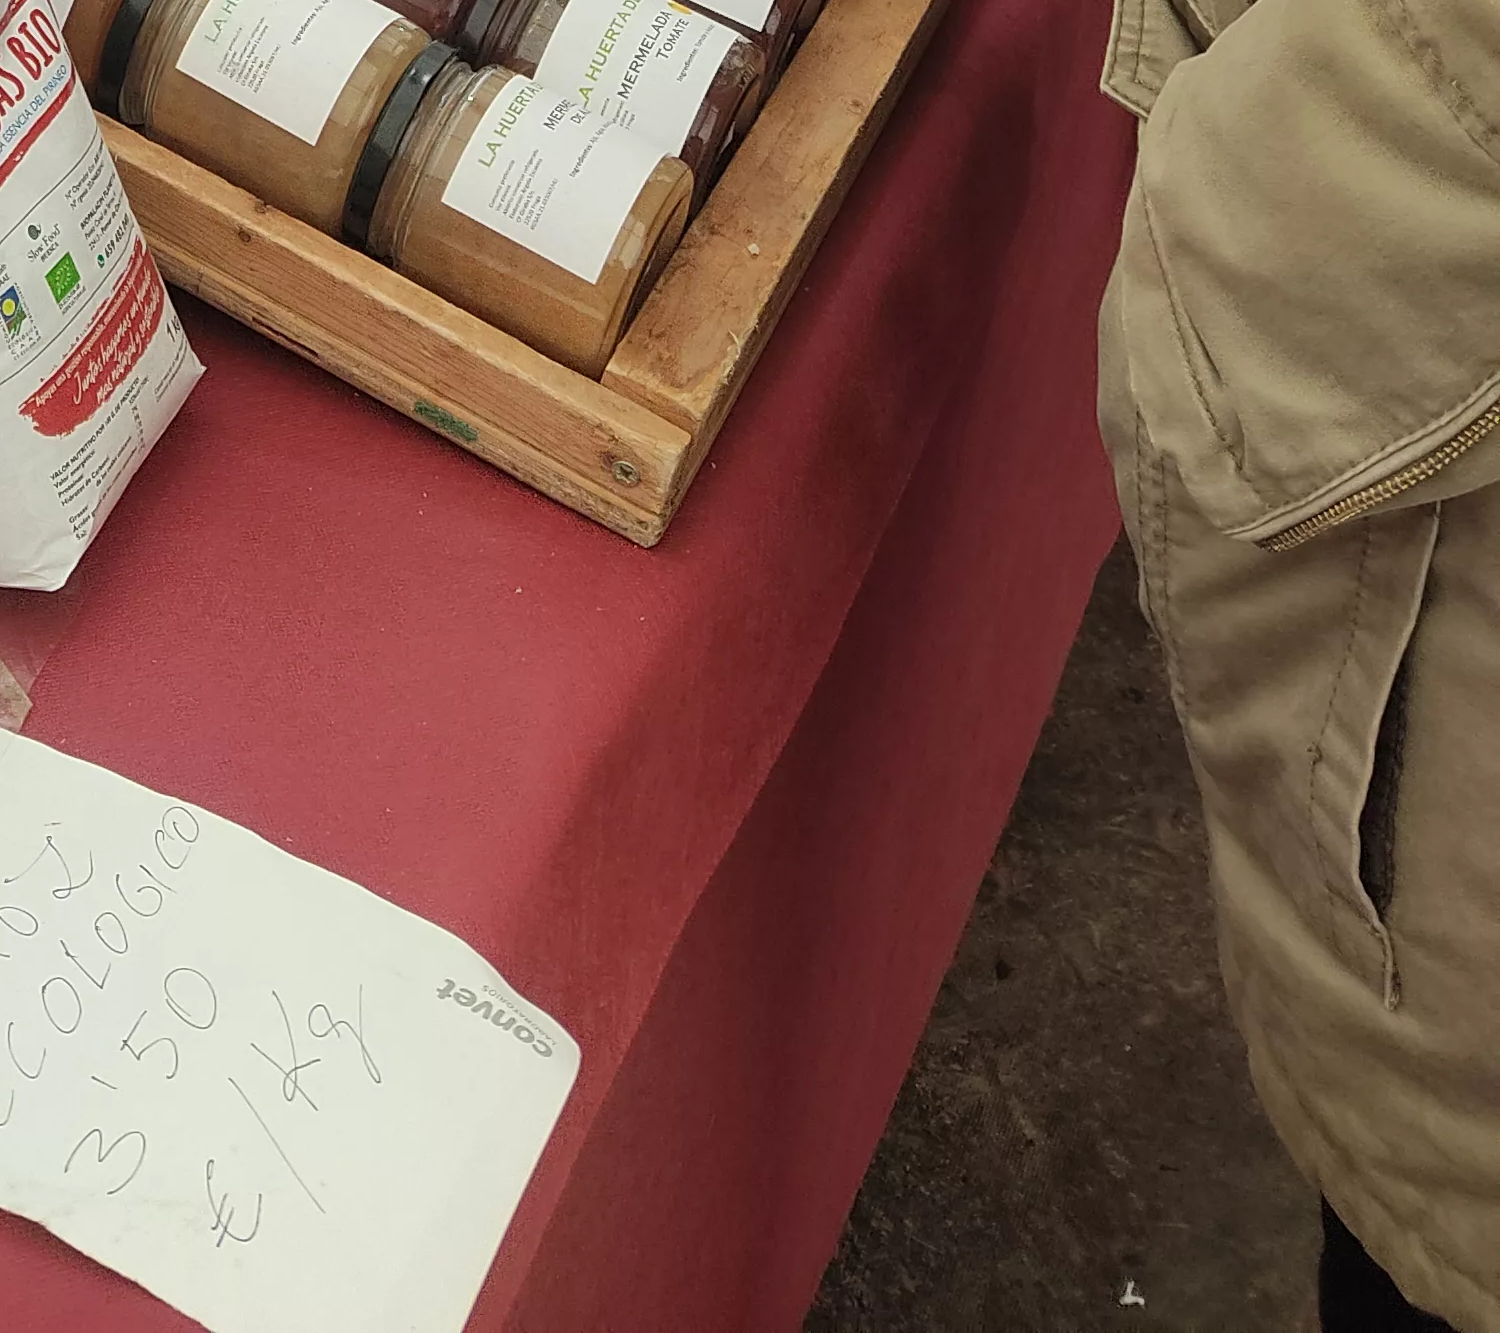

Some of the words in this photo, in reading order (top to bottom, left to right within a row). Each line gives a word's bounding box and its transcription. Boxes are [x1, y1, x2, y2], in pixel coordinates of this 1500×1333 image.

[5, 7, 63, 81] BIO
[575, 84, 594, 110] LA
[589, 13, 631, 82] HUERTA
[616, 9, 672, 101] MERMELADA
[655, 17, 691, 61] TOMATE
[2, 107, 33, 148] ESENCIA
[30, 93, 47, 115] DEL
[44, 63, 68, 101] PIRINEO
[477, 141, 502, 169] LA
[493, 85, 538, 139] HUERTA
[436, 978, 553, 1058] convet
